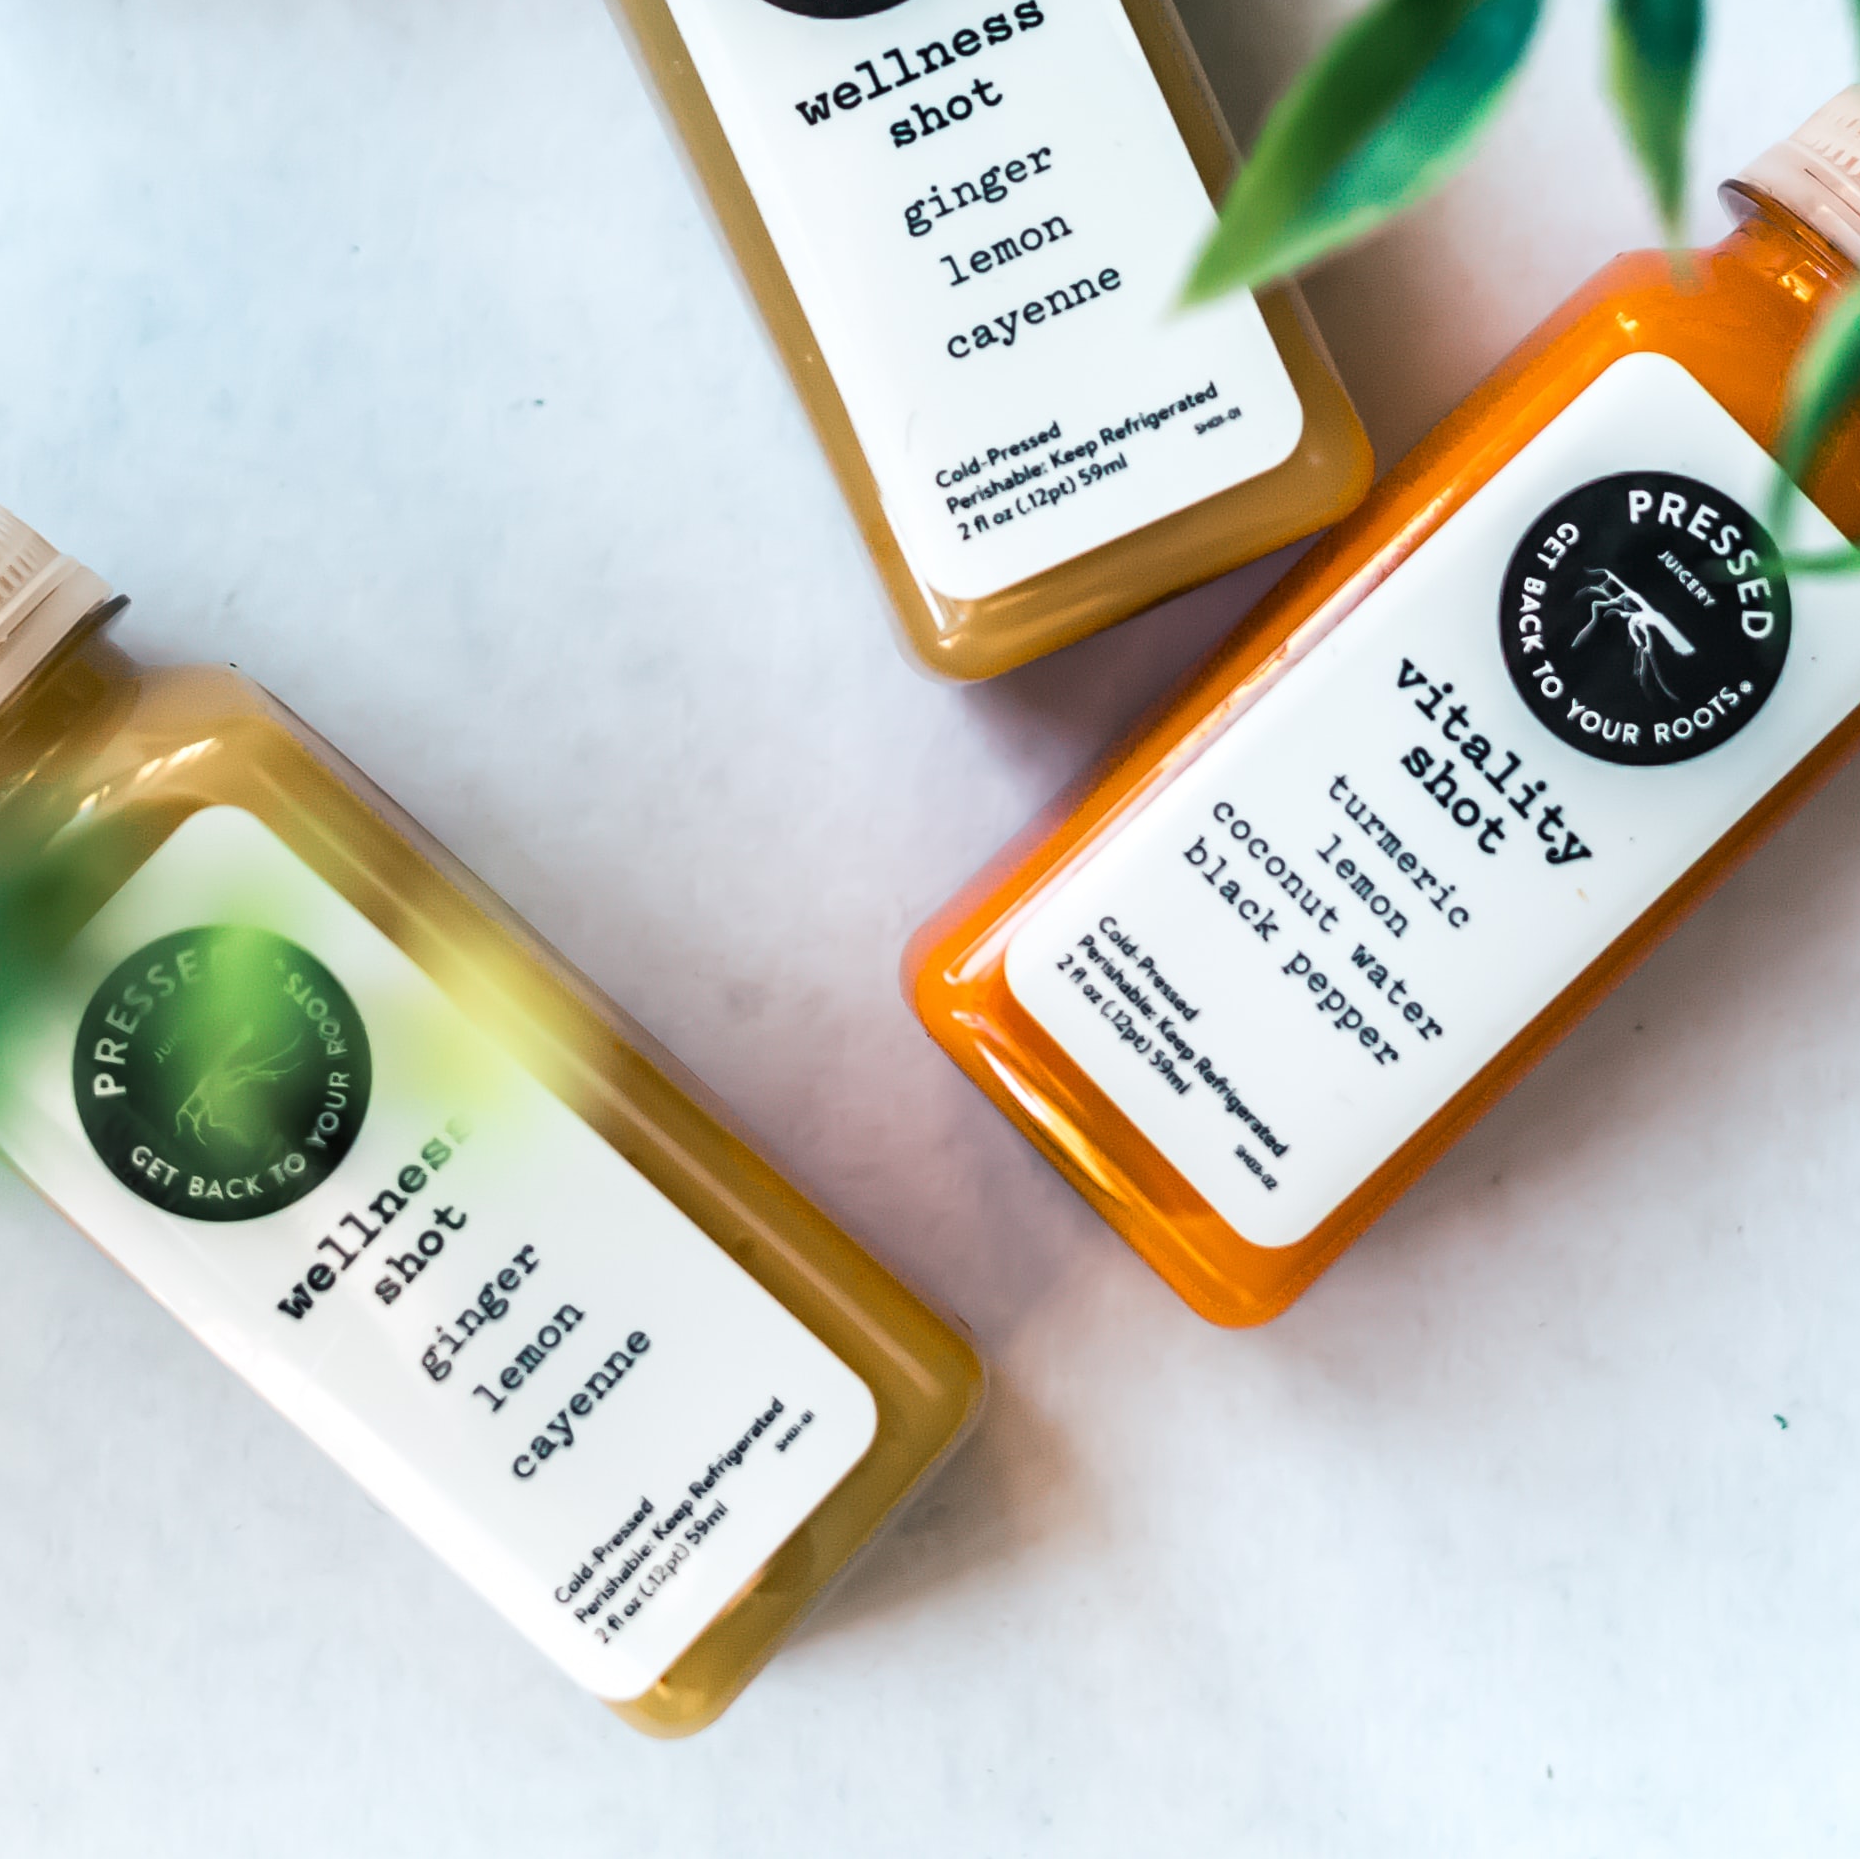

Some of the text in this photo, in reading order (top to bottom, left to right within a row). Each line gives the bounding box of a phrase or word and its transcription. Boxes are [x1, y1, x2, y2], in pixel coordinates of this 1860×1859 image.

[795, 0, 1045, 126] wellness
[889, 78, 1003, 149] shot
[904, 146, 1052, 238] ginger
[940, 216, 1073, 287] lemon
[947, 268, 1121, 359] cayenne
[935, 421, 1062, 488] Cold-Pressed
[946, 381, 1218, 515] Perishable: Keep Refrigerated
[956, 452, 1128, 541] 2 fl oz (.12pt) 59ml
[1537, 522, 1580, 570] GET
[1628, 489, 1774, 639] PRESSED
[1657, 550, 1716, 606] JUICERY
[1518, 576, 1547, 653] BACK
[1532, 660, 1564, 699] TO
[1566, 697, 1640, 744] YOUR
[1397, 658, 1592, 865] vitality
[1400, 746, 1506, 855] shot
[1316, 833, 1408, 939] lemon
[1329, 774, 1470, 929] turmeric
[1099, 916, 1200, 1022] Cold-Pressed
[1183, 835, 1399, 1065] black pepper
[1213, 801, 1443, 1041] coconut water
[91, 948, 198, 1100] PRESSE
[1056, 953, 1192, 1095] 2 fl oz (.12pt) 59ml
[1077, 934, 1289, 1158] Perishable: Keep Refrigerated
[131, 1145, 180, 1186] GET
[188, 1174, 264, 1200] BACK
[268, 1153, 306, 1184] TO
[306, 1071, 350, 1147] YOUR
[375, 1206, 467, 1305] shot
[421, 1244, 539, 1382] ginger
[472, 1304, 585, 1413] lemon
[512, 1331, 650, 1479] cayenne
[555, 1497, 654, 1604] Cold-Pressed
[574, 1397, 785, 1624] Perishable: Keep Refrigerated
[594, 1627, 611, 1645] 2
[607, 1614, 624, 1631] fl
[623, 1597, 642, 1617] oz
[684, 1500, 728, 1545] 59ml
